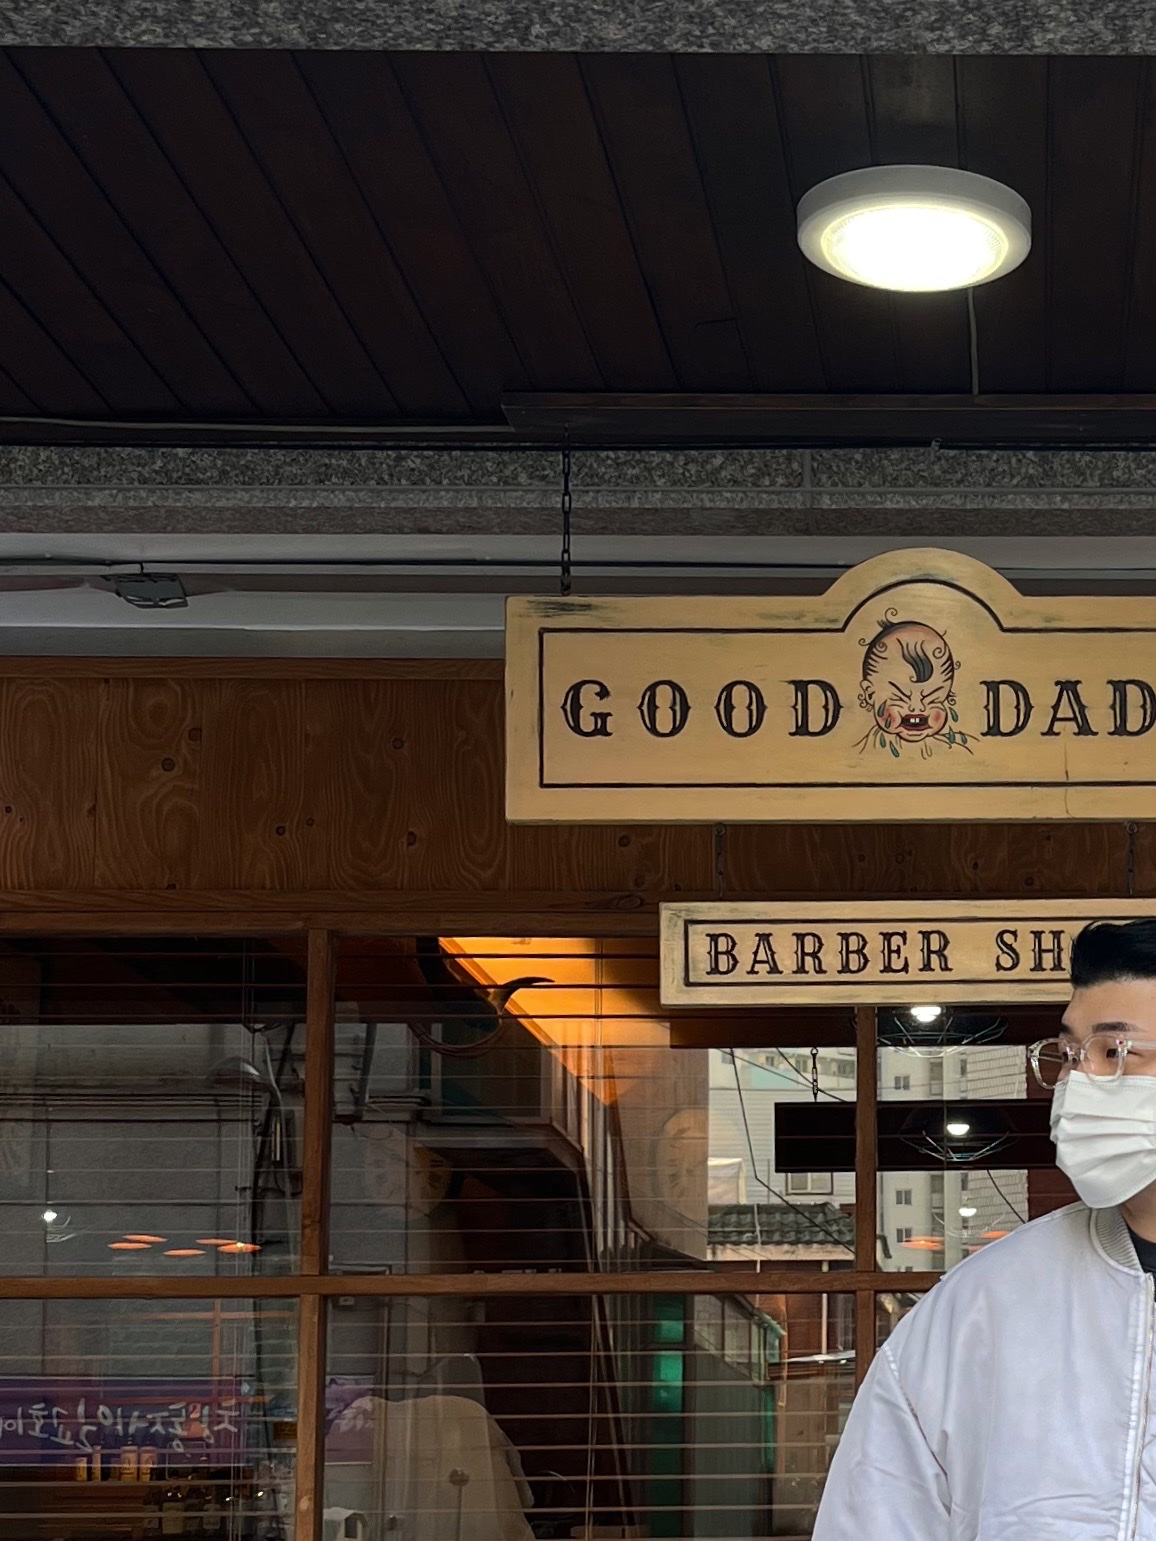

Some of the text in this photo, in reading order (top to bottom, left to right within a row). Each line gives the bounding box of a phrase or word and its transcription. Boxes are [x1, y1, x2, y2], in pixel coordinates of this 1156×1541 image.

[560, 678, 844, 739] GOOD
[705, 928, 1073, 978] BARBER SH
